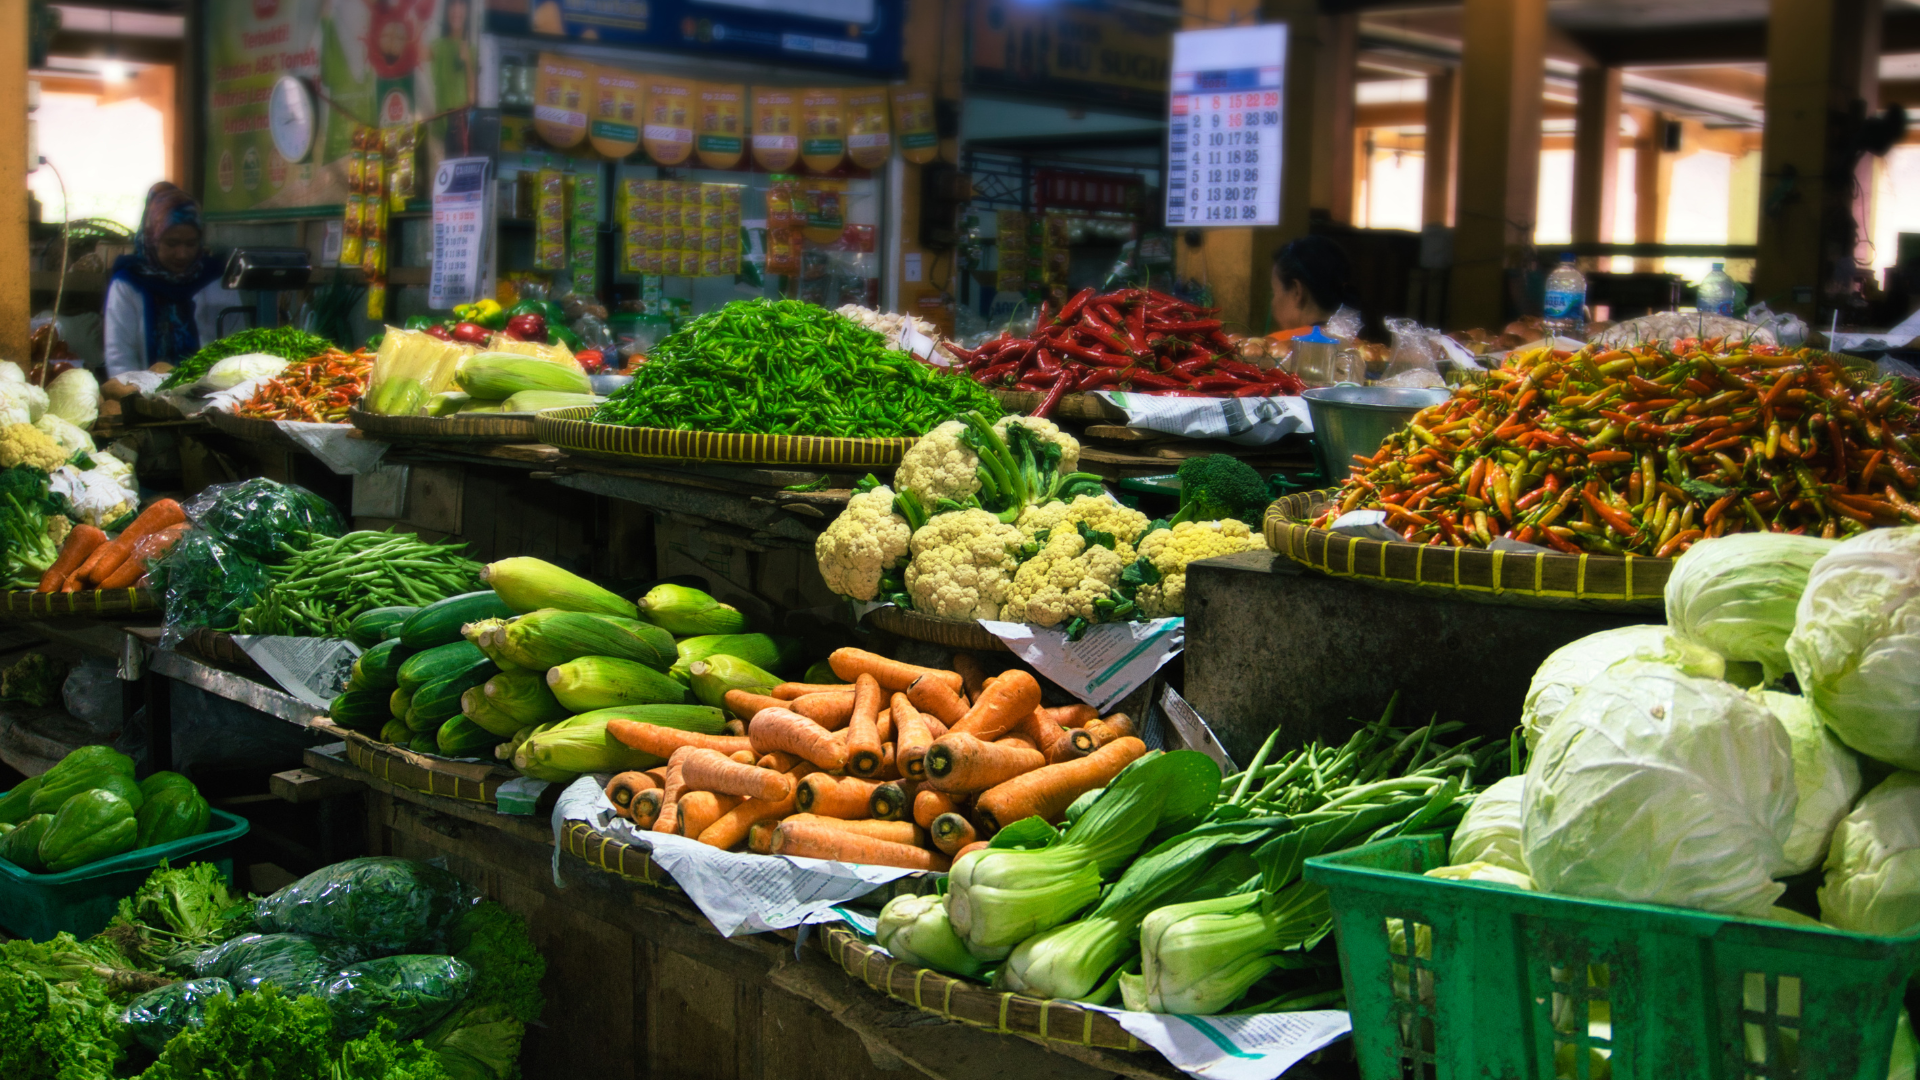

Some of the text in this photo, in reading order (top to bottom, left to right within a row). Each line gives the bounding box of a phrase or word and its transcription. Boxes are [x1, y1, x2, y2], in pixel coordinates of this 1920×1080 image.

[255, 54, 277, 75] ABC
[546, 65, 557, 76] Rp
[599, 77, 610, 87] Rp
[652, 86, 663, 95] Rp
[702, 93, 713, 102] Rp
[758, 96, 769, 106] Rp
[803, 97, 814, 106] Rp
[1195, 97, 1200, 109] 1
[1213, 96, 1220, 109] 8
[1229, 95, 1242, 108] 15
[1246, 93, 1260, 107] 22
[1264, 92, 1278, 106] 29
[1193, 115, 1201, 128] 2
[1212, 114, 1220, 128] 9
[1229, 113, 1242, 127] 16
[1245, 112, 1259, 126] 23
[1263, 111, 1278, 125] 30
[1192, 133, 1200, 146] 3
[1209, 133, 1223, 146] 10
[1228, 132, 1241, 145] 17
[1245, 131, 1259, 144] 24
[1192, 151, 1200, 164] 4
[1209, 151, 1221, 164] 11
[1227, 150, 1241, 164] 18
[1245, 149, 1259, 163] 25
[1192, 170, 1199, 183] 5
[1208, 169, 1222, 182] 12
[1227, 169, 1240, 182] 19
[1244, 168, 1258, 182] 26
[1191, 188, 1199, 201] 6
[1207, 188, 1221, 201] 13
[1225, 187, 1240, 201] 20
[1243, 187, 1258, 200] 27
[1191, 206, 1199, 219] 7
[1206, 206, 1220, 219] 14
[1224, 206, 1238, 219] 21
[1242, 205, 1257, 219] 28
